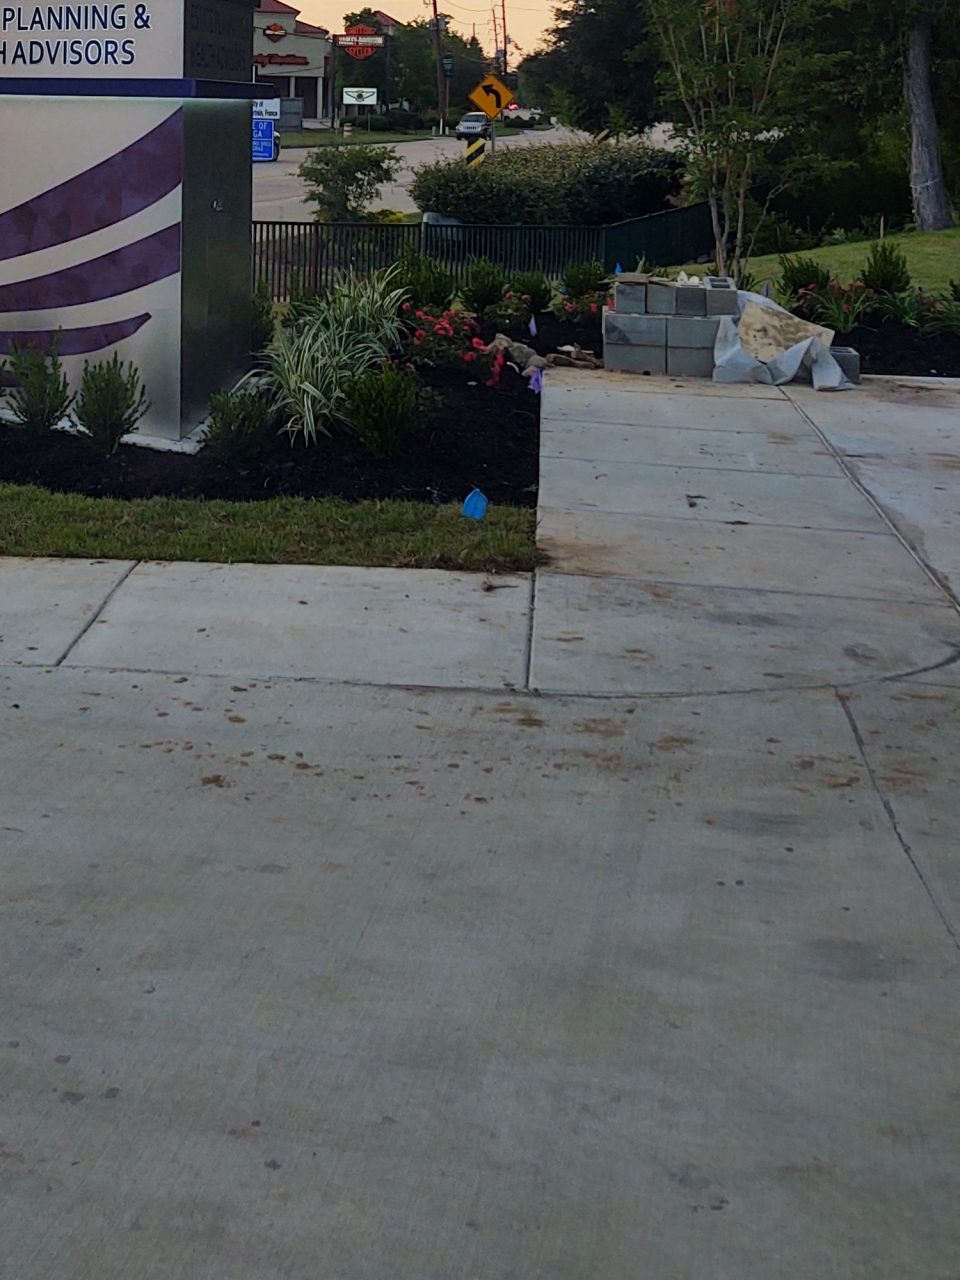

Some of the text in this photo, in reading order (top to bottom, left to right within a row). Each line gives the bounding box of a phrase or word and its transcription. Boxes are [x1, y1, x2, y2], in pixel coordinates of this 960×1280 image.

[2, 4, 126, 32] PLANNING
[133, 3, 152, 29] &
[11, 39, 136, 65] ADVISORS
